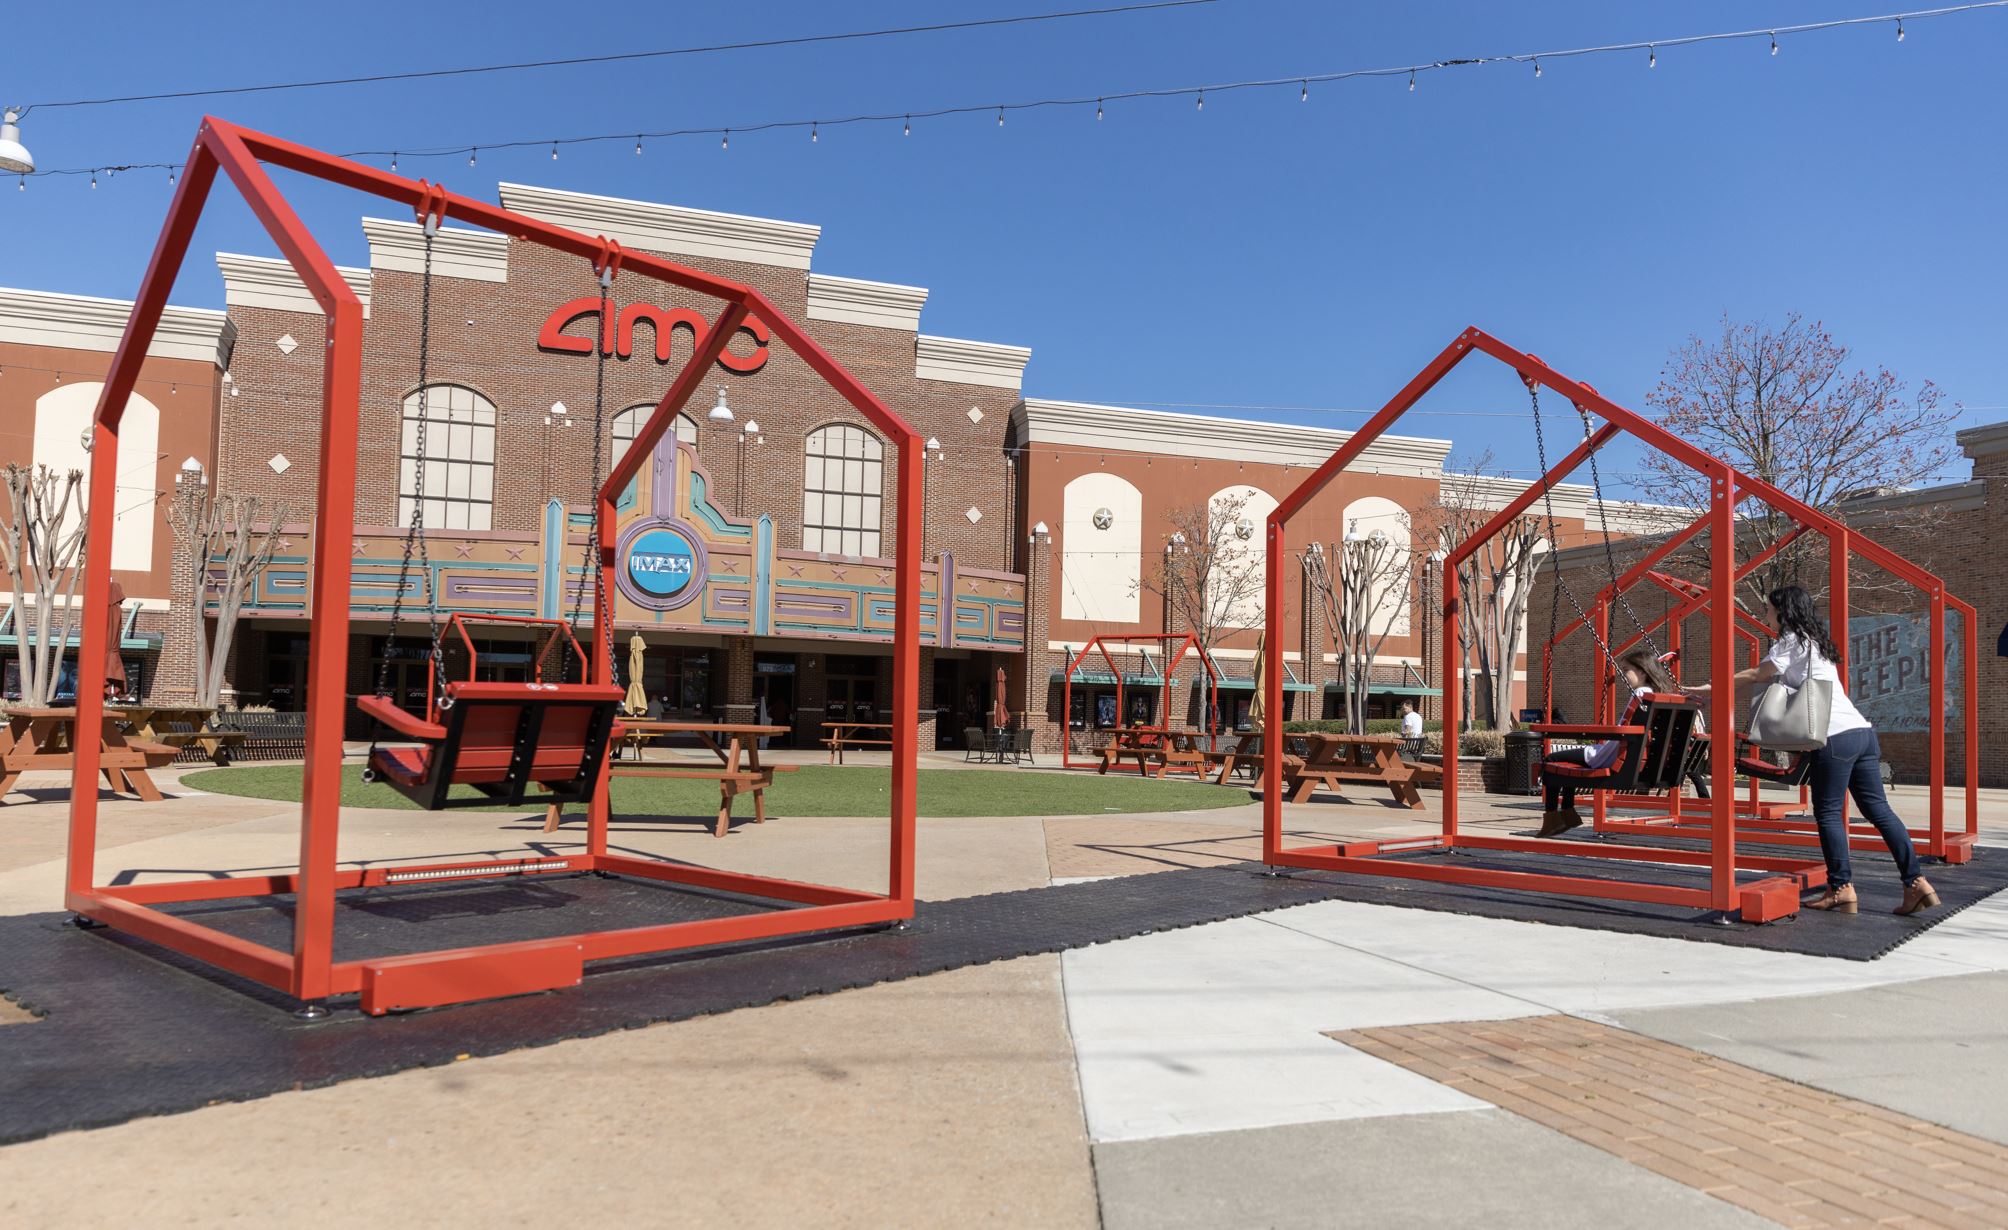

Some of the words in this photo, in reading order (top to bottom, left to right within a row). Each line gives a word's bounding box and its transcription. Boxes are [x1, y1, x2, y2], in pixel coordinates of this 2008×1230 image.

[538, 297, 769, 372] amc
[631, 551, 691, 574] IMAX
[1852, 625, 1898, 664] THE
